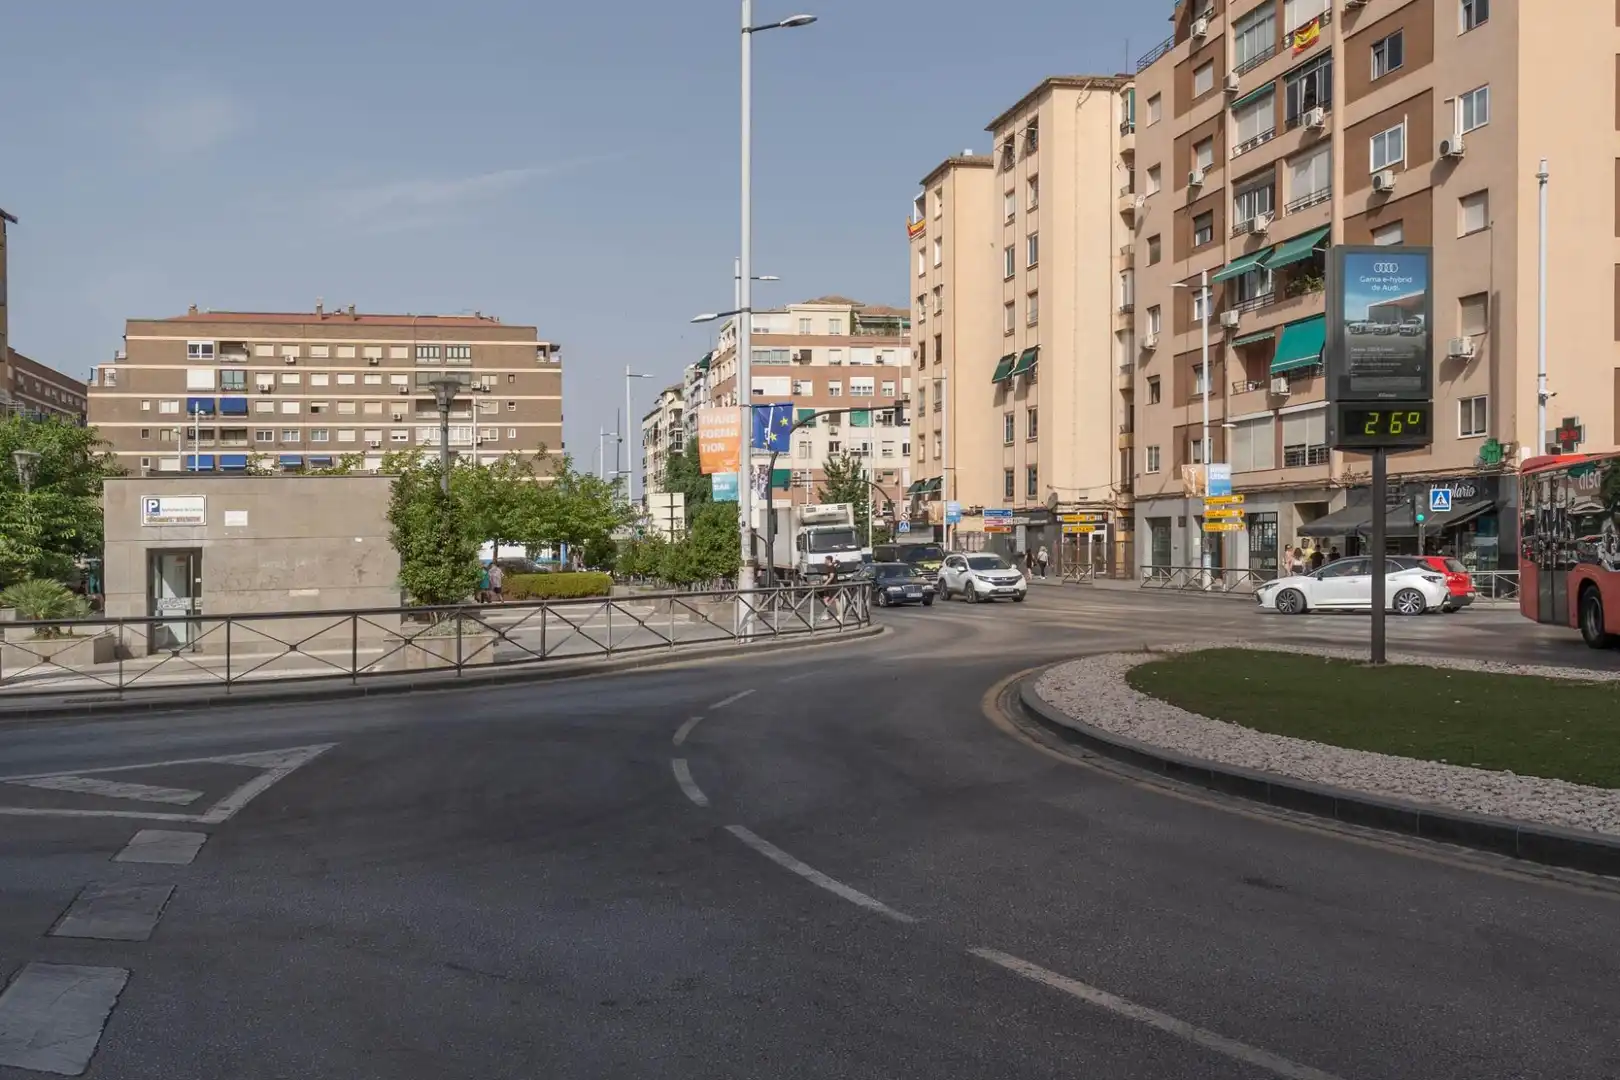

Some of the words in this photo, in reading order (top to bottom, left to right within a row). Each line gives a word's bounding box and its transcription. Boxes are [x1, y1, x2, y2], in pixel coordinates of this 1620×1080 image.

[1382, 276, 1412, 284] e-hybrid
[700, 428, 738, 439] FORMA
[701, 442, 725, 453] TION
[1578, 469, 1602, 490] alsa
[148, 499, 159, 512] P
